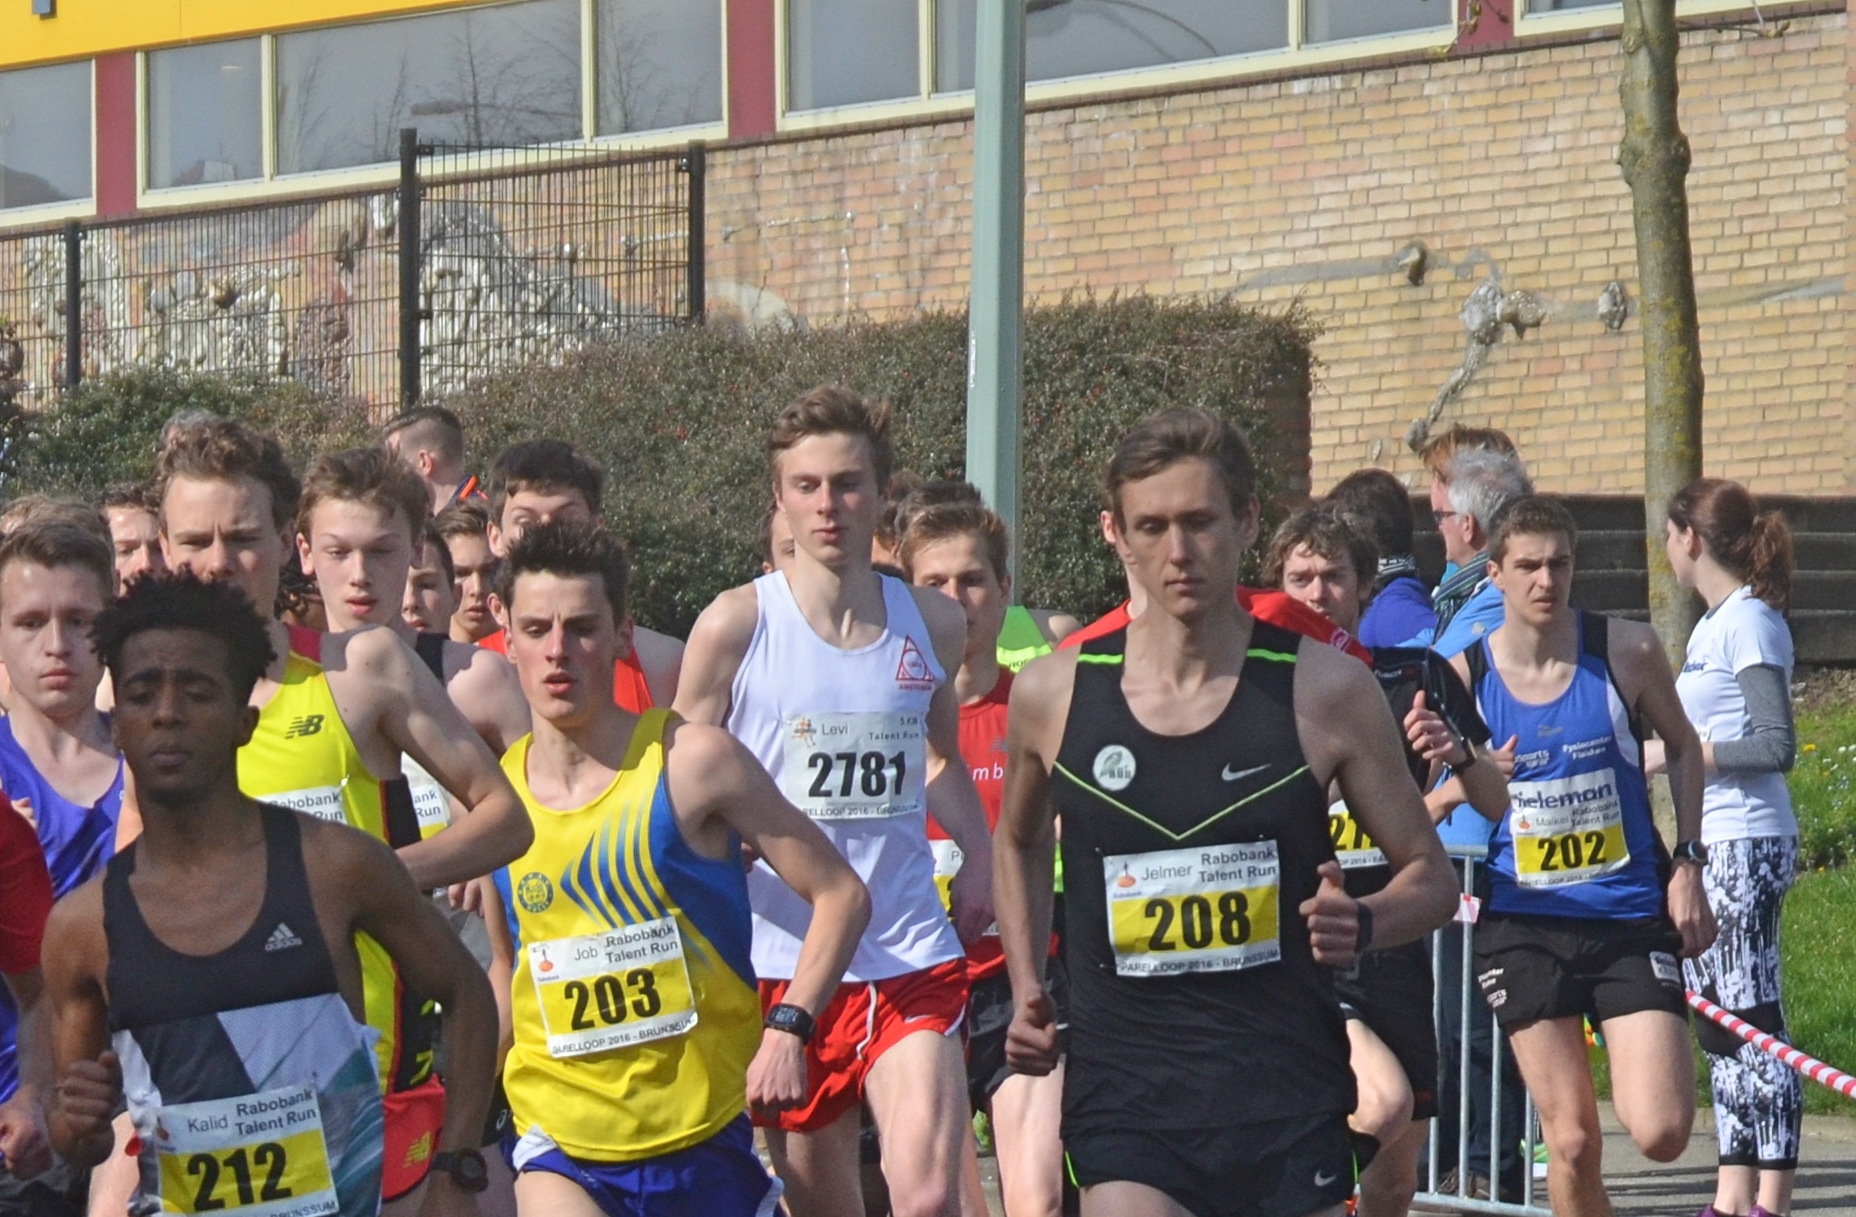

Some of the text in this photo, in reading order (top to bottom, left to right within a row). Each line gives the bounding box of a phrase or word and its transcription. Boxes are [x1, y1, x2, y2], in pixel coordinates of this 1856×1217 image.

[821, 723, 849, 736] Levi
[899, 716, 906, 726] 5
[868, 731, 920, 741] Talent Run
[807, 750, 906, 798] 2781
[847, 806, 870, 816] 2016
[1571, 801, 1619, 817] Rabobank
[1571, 815, 1601, 827] Talent
[1201, 847, 1276, 866] Rabobank
[1537, 830, 1607, 872] 202
[1141, 865, 1193, 882] Jelmer
[1198, 865, 1277, 883] Talent Run
[1144, 891, 1252, 951] 208
[605, 923, 675, 948] Rabobank
[574, 945, 599, 962] Job
[605, 939, 678, 965] Talent Run
[1188, 960, 1214, 970] 2016
[563, 967, 662, 1031] 203
[608, 1032, 631, 1046] 2016
[235, 1087, 313, 1117] Rabobank
[186, 1114, 229, 1133] Kalid
[235, 1106, 317, 1136] Talent Run
[186, 1142, 293, 1213] 212
